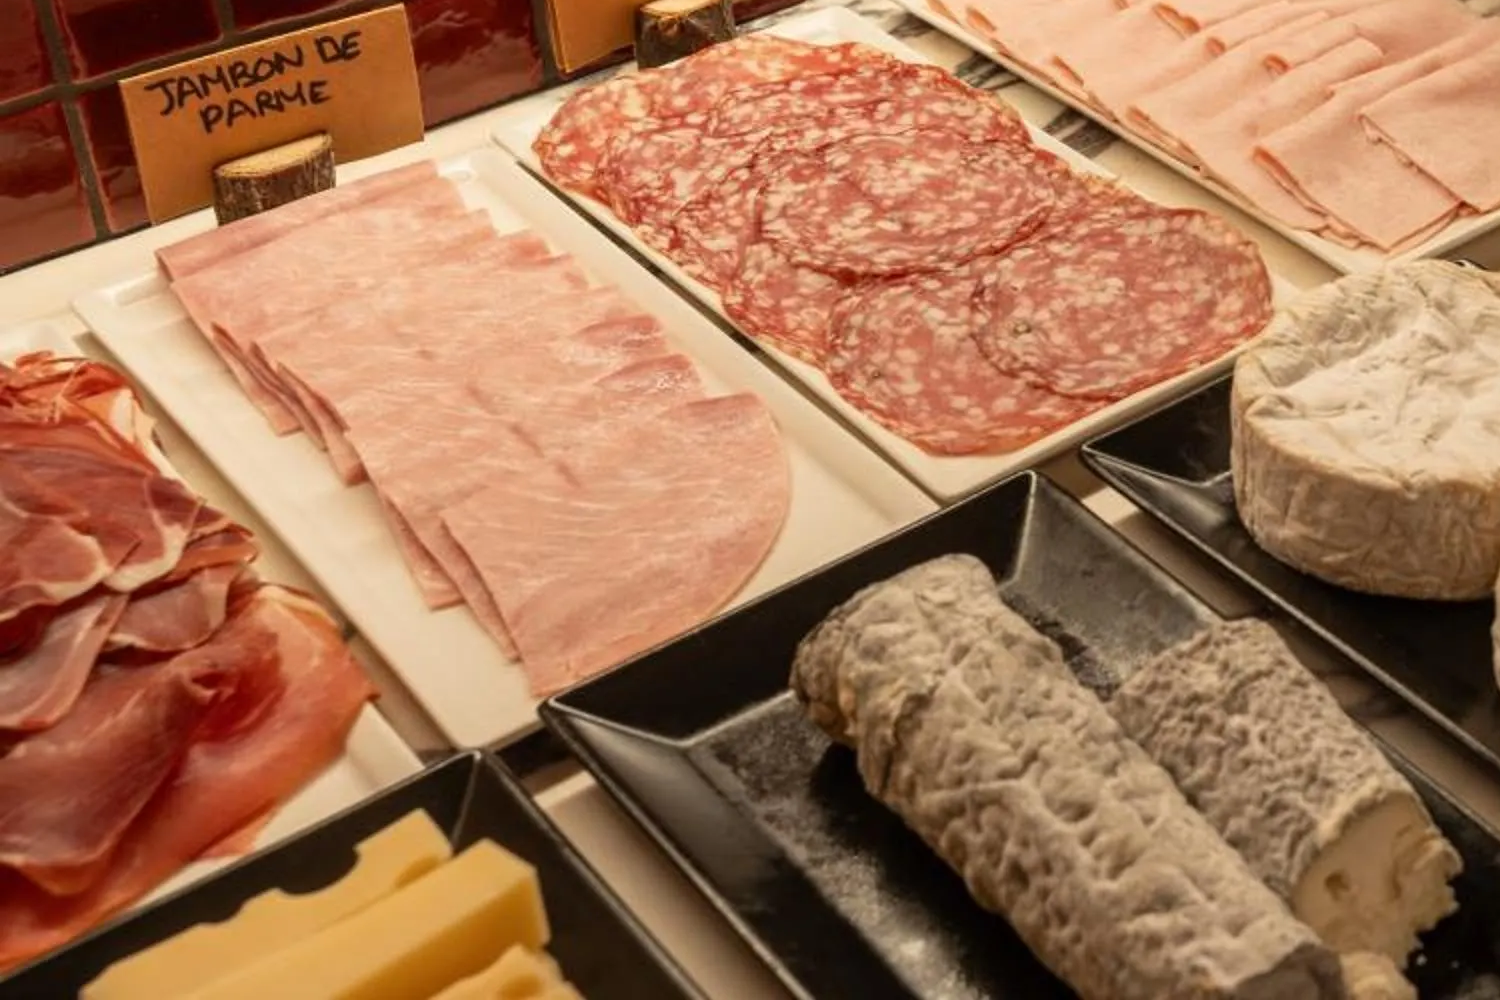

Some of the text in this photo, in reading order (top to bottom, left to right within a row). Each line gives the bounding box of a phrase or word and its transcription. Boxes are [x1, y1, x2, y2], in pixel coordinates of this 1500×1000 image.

[144, 30, 363, 117] JAMBON DE
[198, 79, 334, 134] PARME
